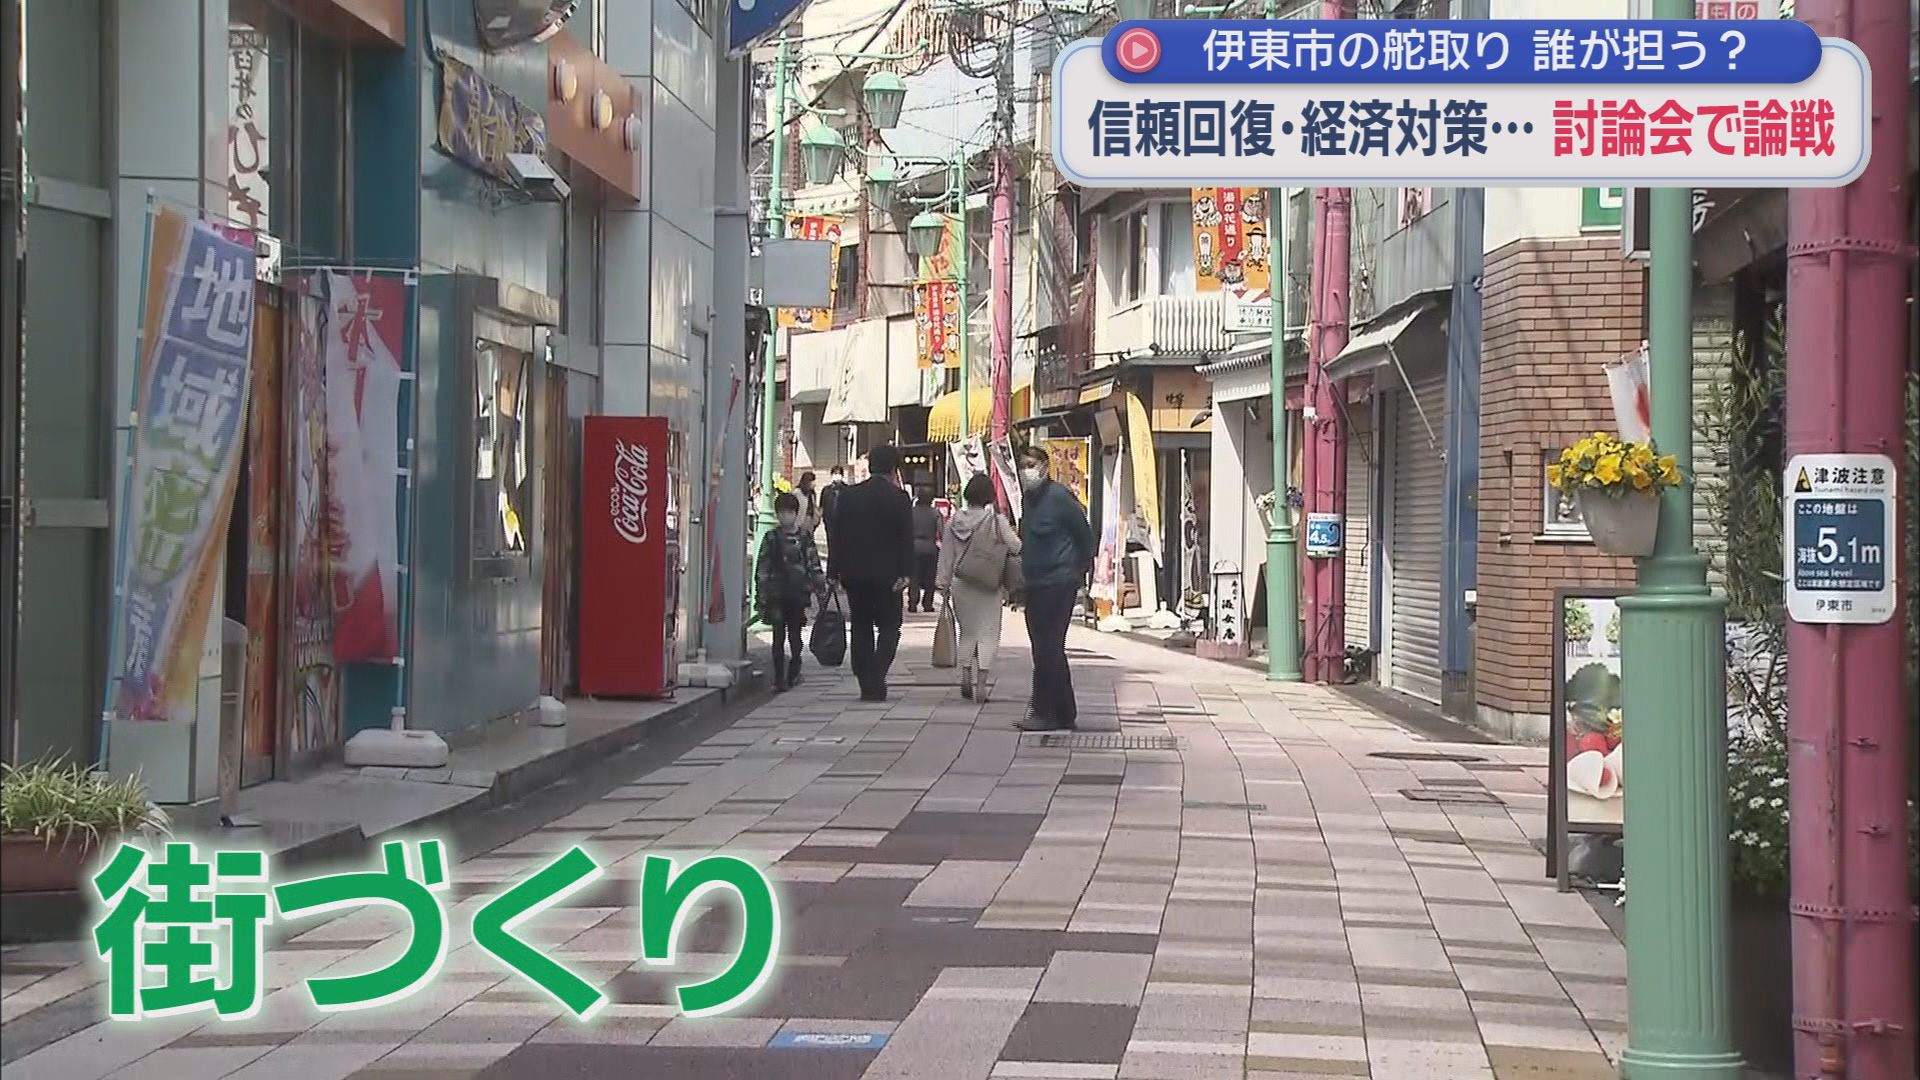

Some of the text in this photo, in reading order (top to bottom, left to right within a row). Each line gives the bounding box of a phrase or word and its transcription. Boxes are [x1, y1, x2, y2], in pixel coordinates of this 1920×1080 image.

[1814, 467, 1885, 485] 津波注意
[613, 437, 649, 544] Coca-Cola
[1798, 503, 1858, 515] ここの地盤は
[1816, 569, 1829, 577] sea
[1831, 568, 1853, 577] level
[1816, 599, 1853, 612] 伊東市
